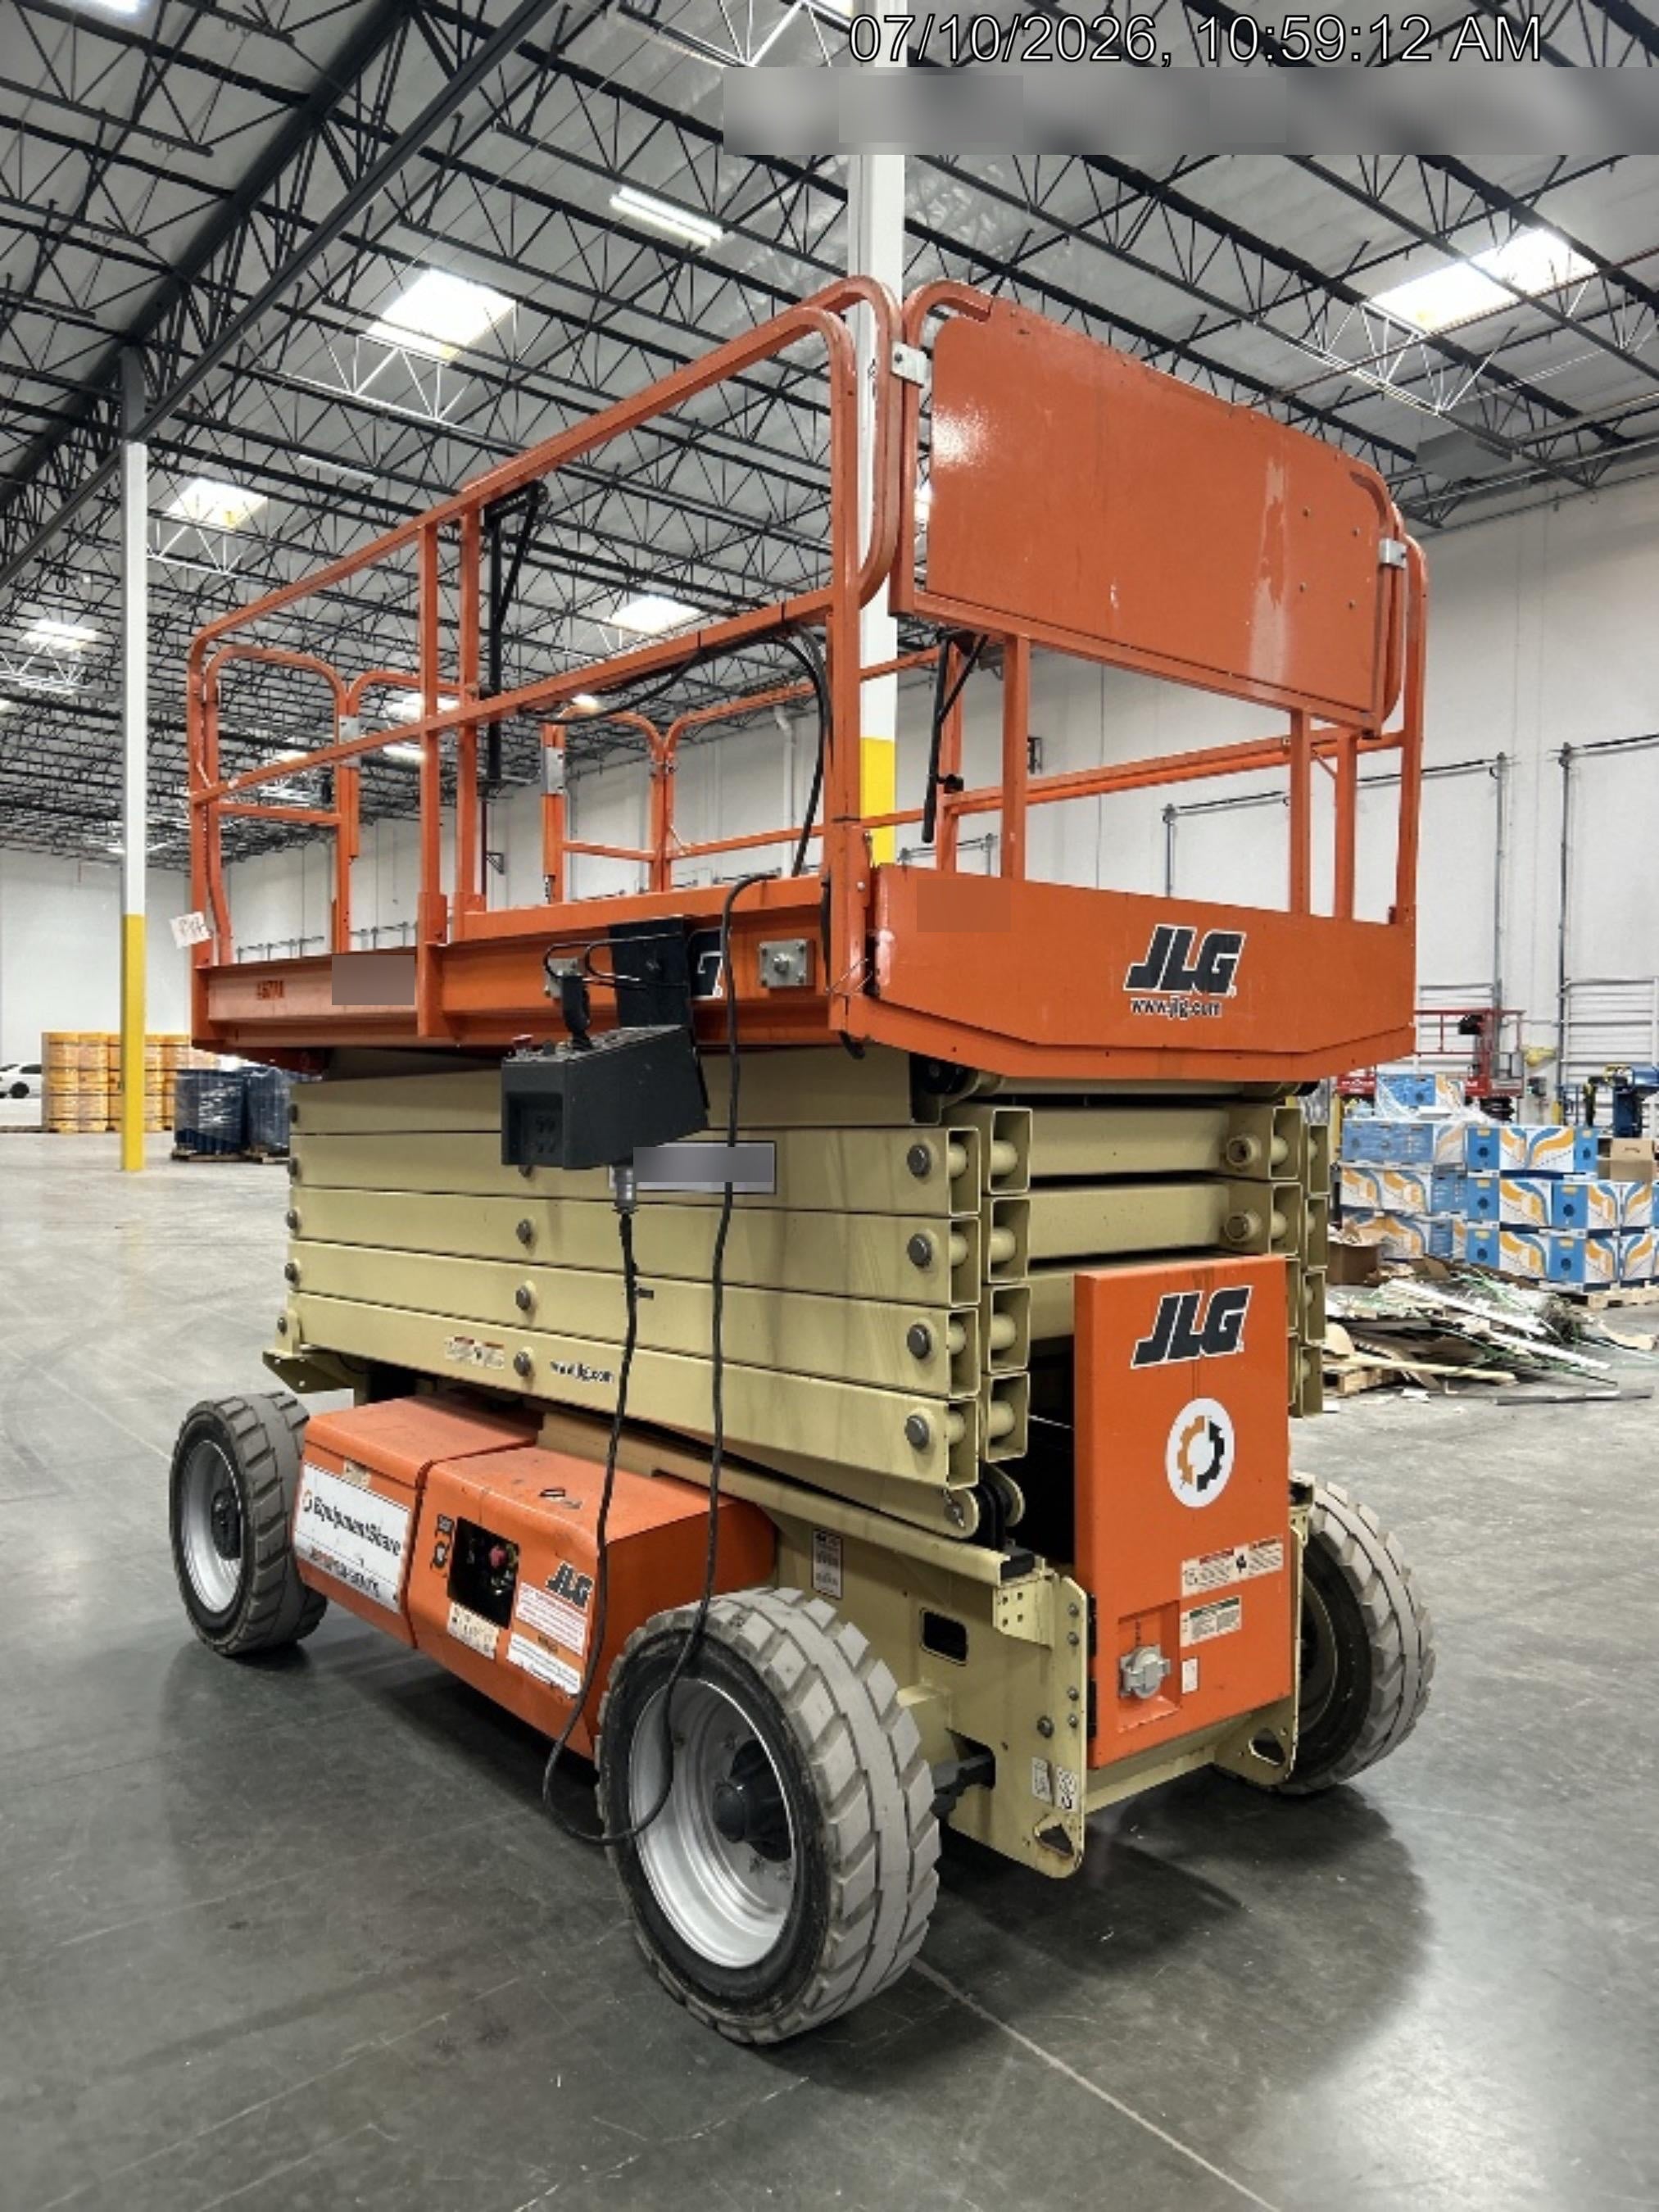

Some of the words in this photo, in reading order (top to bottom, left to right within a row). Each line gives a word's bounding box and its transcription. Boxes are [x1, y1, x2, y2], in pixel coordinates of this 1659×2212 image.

[1123, 923, 1247, 998] JLG
[1130, 1285, 1254, 1370] JLG
[546, 1561, 595, 1612] JLG
